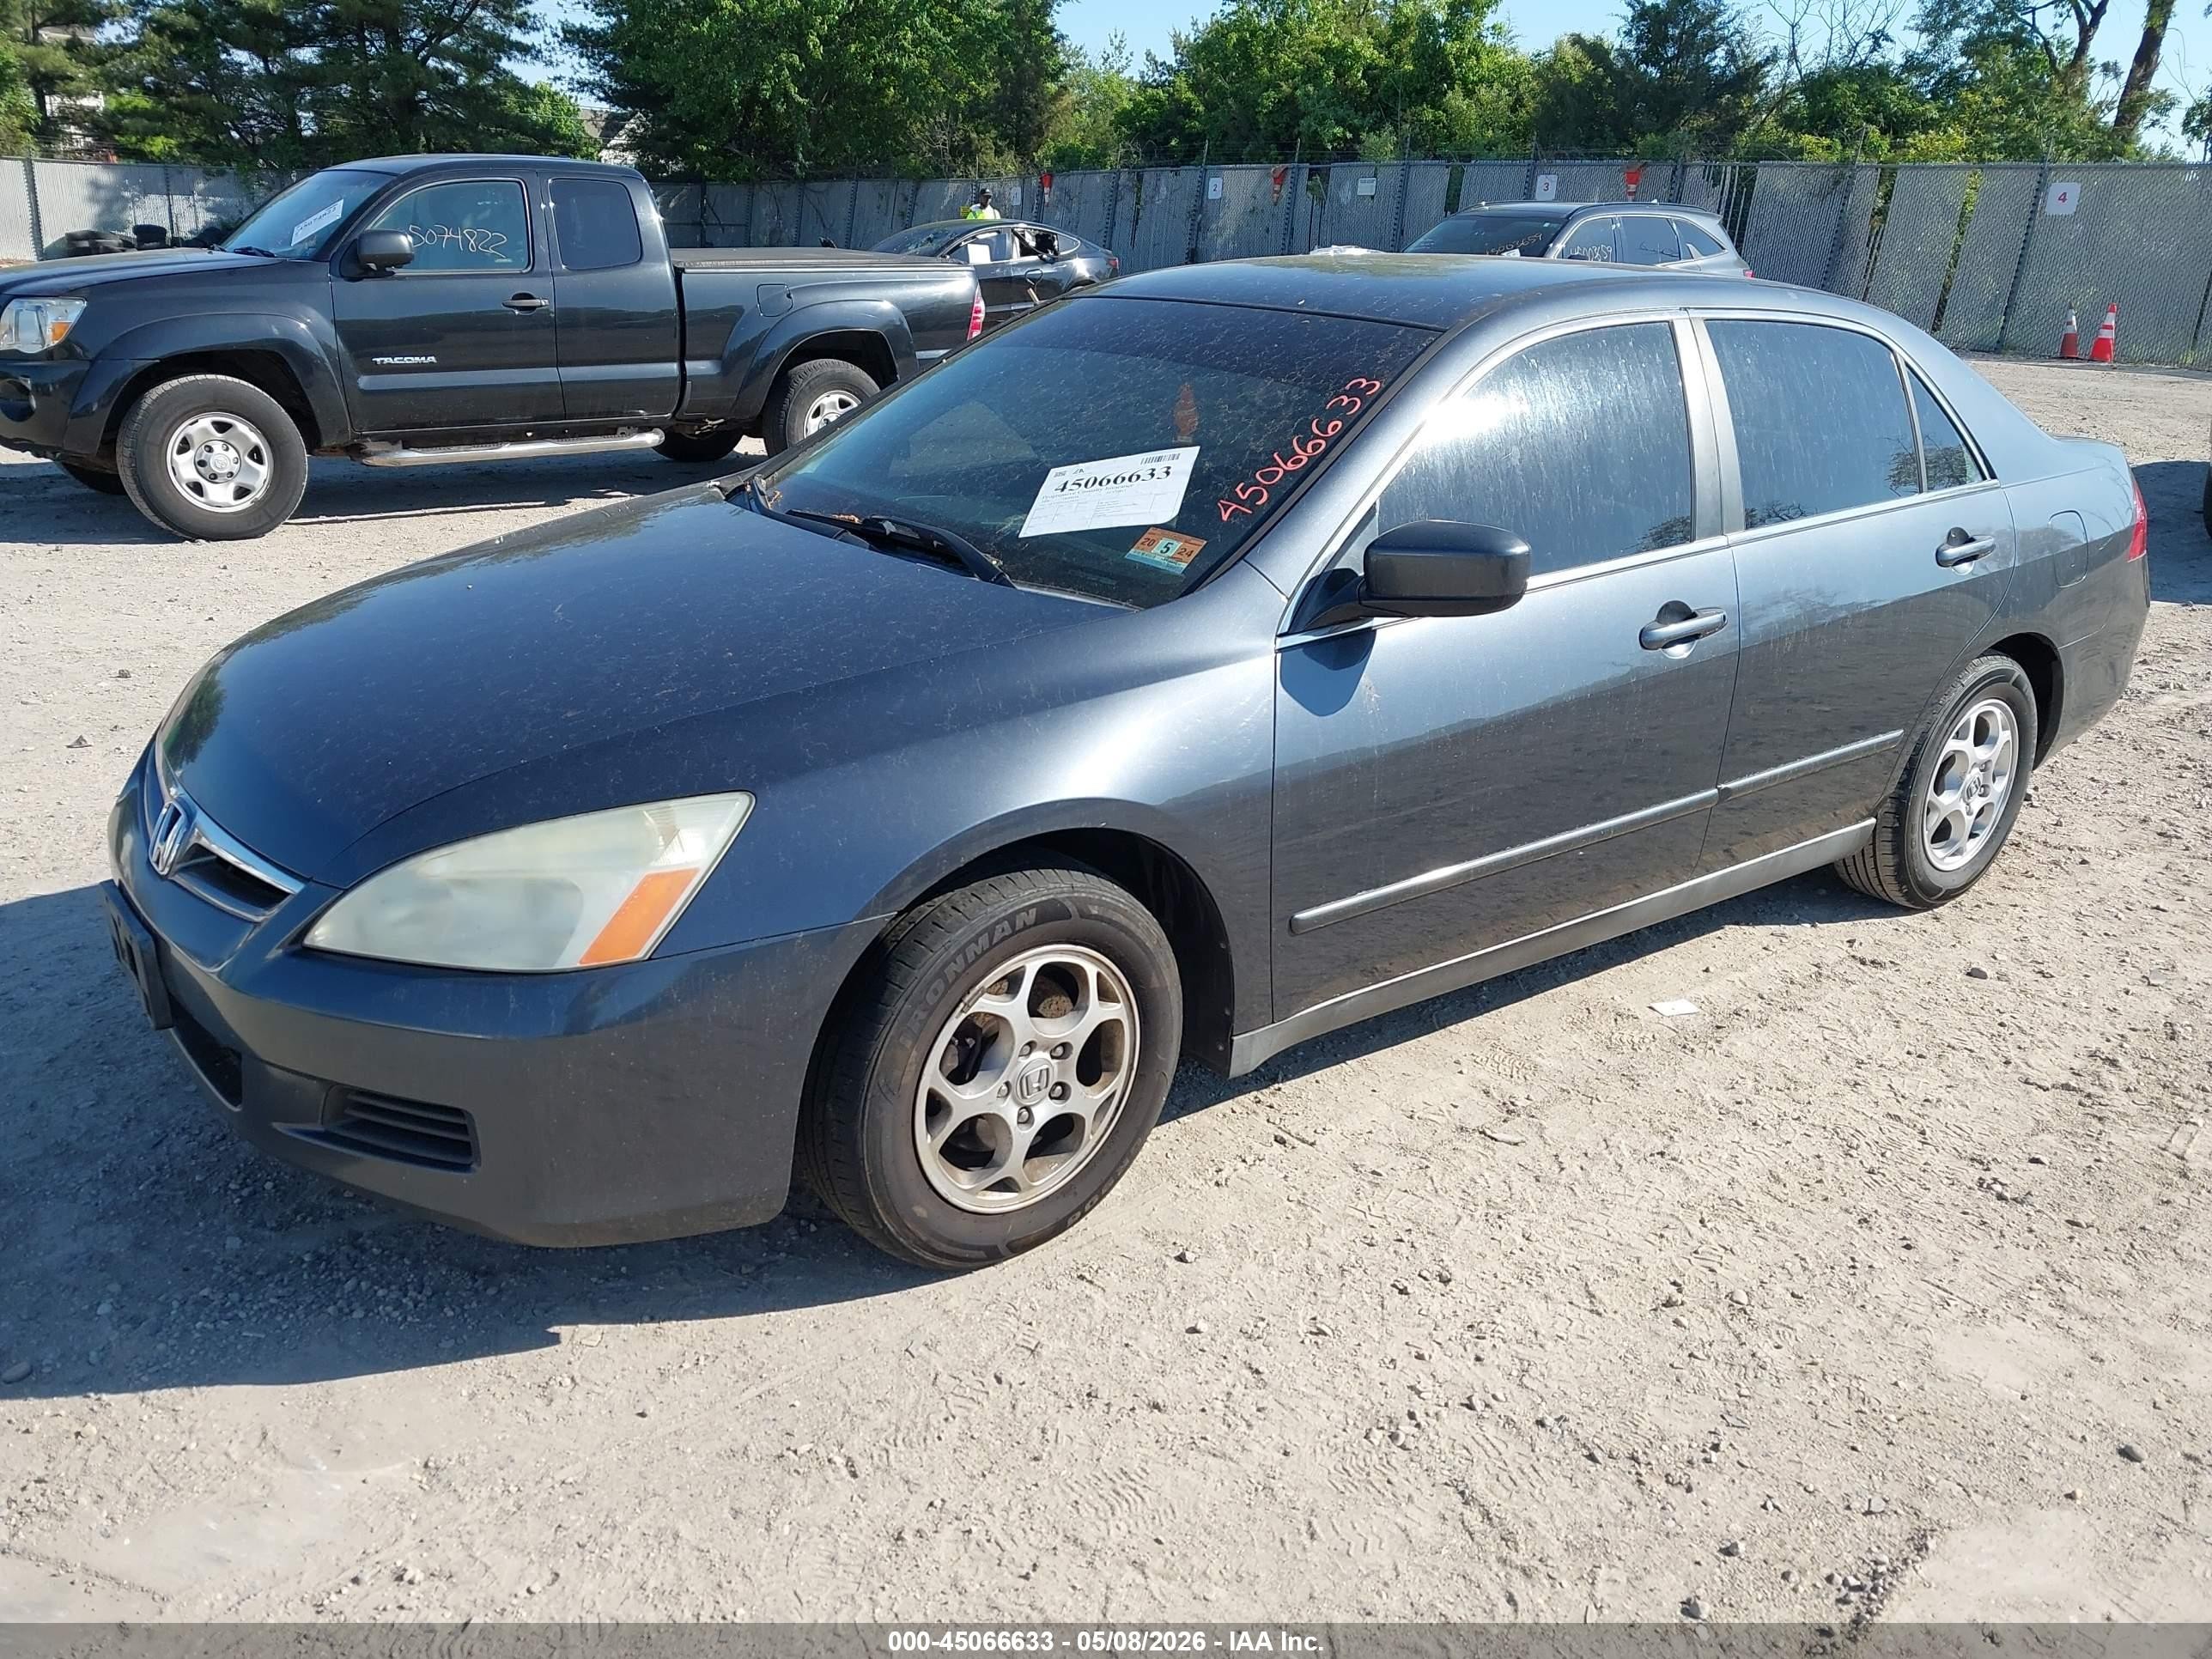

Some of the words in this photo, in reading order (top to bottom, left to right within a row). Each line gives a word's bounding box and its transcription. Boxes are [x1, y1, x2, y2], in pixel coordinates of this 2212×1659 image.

[1212, 183, 1218, 192] 2
[1543, 182, 1550, 191] 3
[2057, 191, 2068, 204] 4
[372, 356, 437, 365] TACOMA
[1218, 378, 1381, 521] 45066633
[1054, 465, 1172, 493] 45066633
[1140, 538, 1156, 547] 20
[1160, 542, 1174, 554] 5
[1177, 548, 1194, 557] 24
[899, 907, 1037, 1046] IRONMAN
